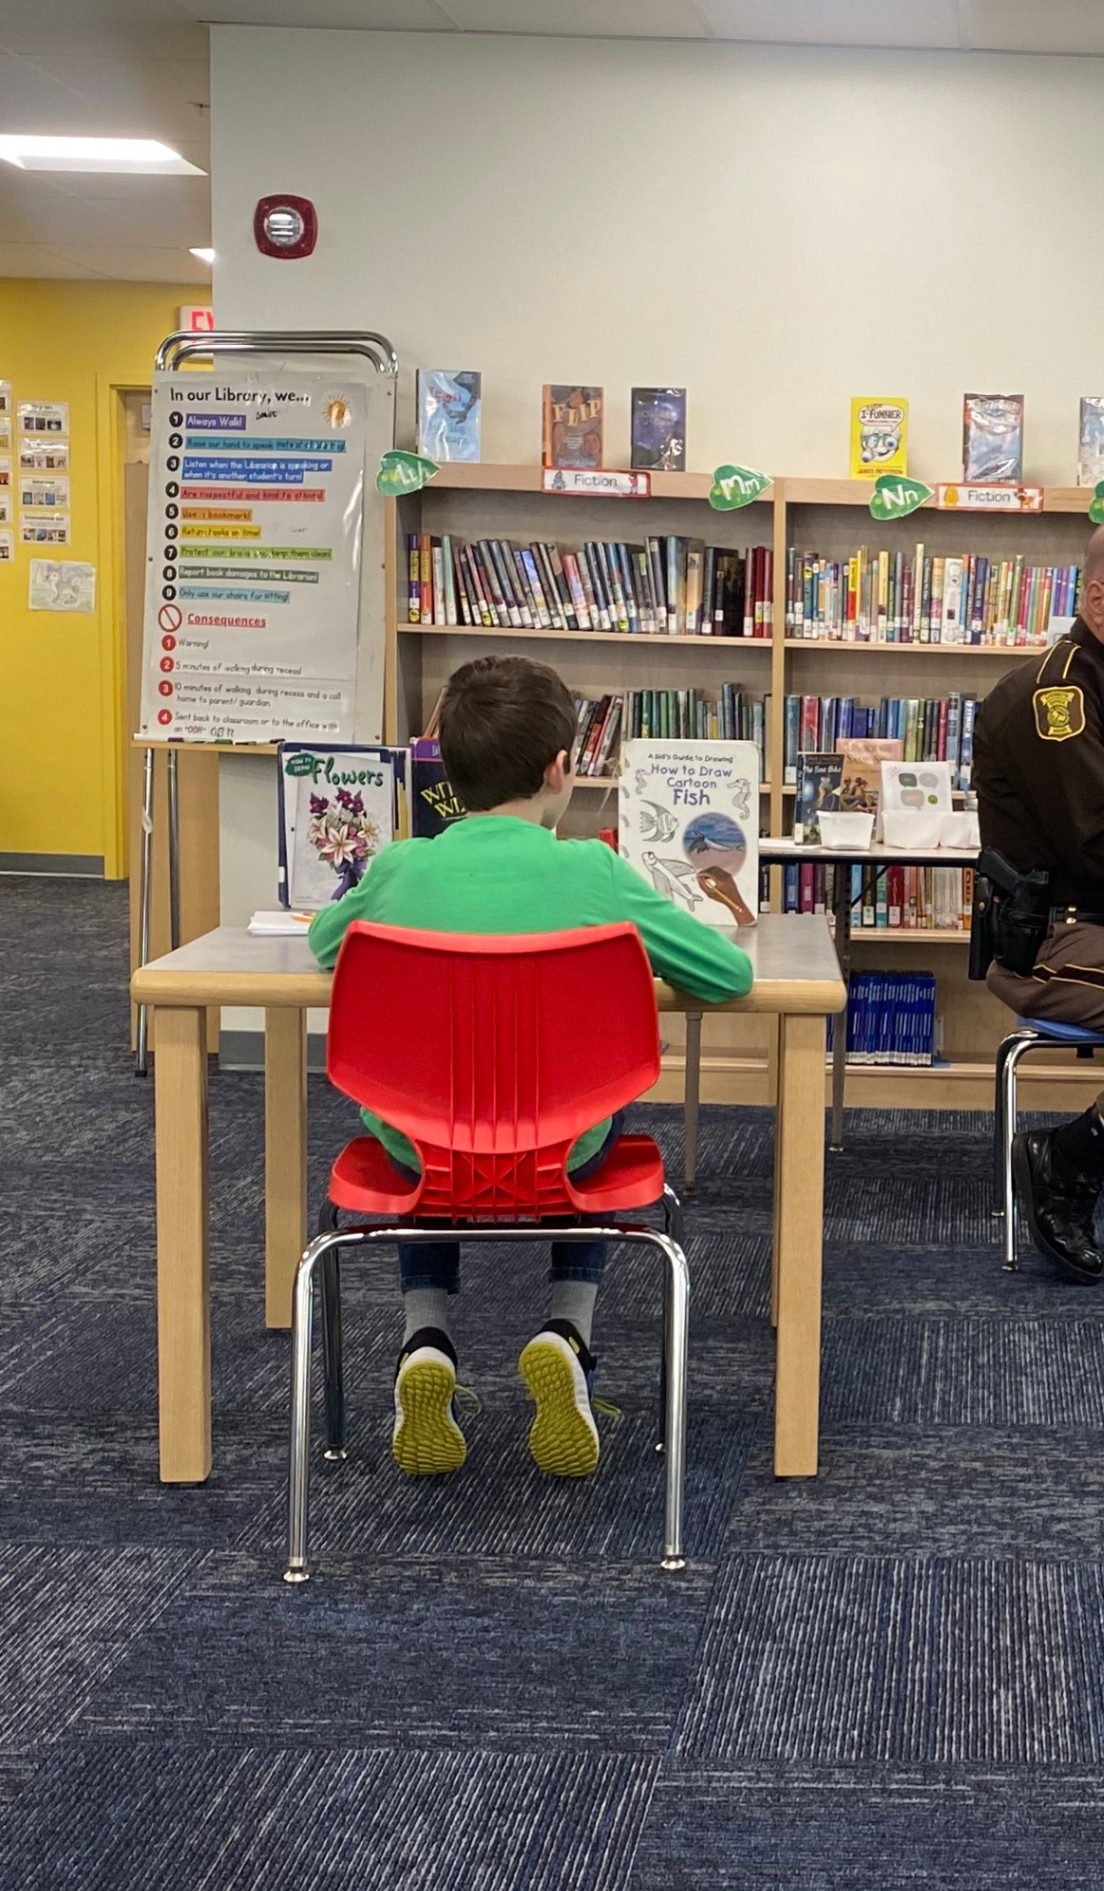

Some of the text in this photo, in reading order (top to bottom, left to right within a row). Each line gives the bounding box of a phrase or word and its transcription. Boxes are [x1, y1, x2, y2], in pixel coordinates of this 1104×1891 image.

[170, 387, 183, 401] In
[187, 391, 211, 401] our
[215, 387, 272, 404] Library,
[552, 399, 602, 427] FLIP
[187, 417, 217, 429] Always
[184, 459, 207, 469] Listen
[209, 461, 229, 469] when
[230, 460, 243, 469] the
[244, 460, 278, 470] Librarian
[279, 462, 286, 470] is
[287, 461, 319, 472] speaking
[184, 471, 203, 479] when
[217, 471, 247, 480] another
[574, 473, 618, 489] Fiction
[182, 489, 197, 498] Are
[719, 473, 761, 500] Mm
[881, 484, 919, 511] Nn
[967, 489, 1011, 503] Fiction
[181, 527, 207, 537] Return
[179, 567, 205, 578] Report
[206, 569, 224, 578] book
[225, 570, 258, 580] damages
[259, 570, 269, 579] to
[269, 571, 281, 579] the
[179, 588, 195, 599] Only
[198, 591, 210, 599] use
[211, 591, 224, 600] our
[227, 591, 249, 601] chairs
[250, 591, 263, 600] for
[187, 613, 267, 628] Consequences
[175, 661, 181, 670] 5
[182, 663, 211, 672] minutes
[212, 662, 222, 672] of
[251, 663, 274, 675] during
[177, 695, 197, 704] home
[199, 696, 207, 704] to
[183, 684, 212, 693] minutes
[213, 684, 223, 693] of
[225, 685, 252, 696] walking
[255, 686, 279, 697] during
[280, 689, 305, 698] recess
[306, 690, 321, 700] and
[329, 691, 342, 701] call
[174, 712, 192, 722] Sent
[193, 713, 210, 723] back
[212, 715, 221, 723] to
[222, 714, 259, 725] classroom
[260, 718, 270, 726] or
[271, 717, 281, 726] to
[281, 718, 294, 728] the
[295, 719, 320, 729] office
[673, 754, 694, 762] Guide
[704, 755, 734, 764] Drawing
[312, 756, 384, 787] Flowers
[651, 763, 733, 778] How to Draw
[666, 776, 718, 789] Cartoon
[673, 789, 711, 806] Fish
